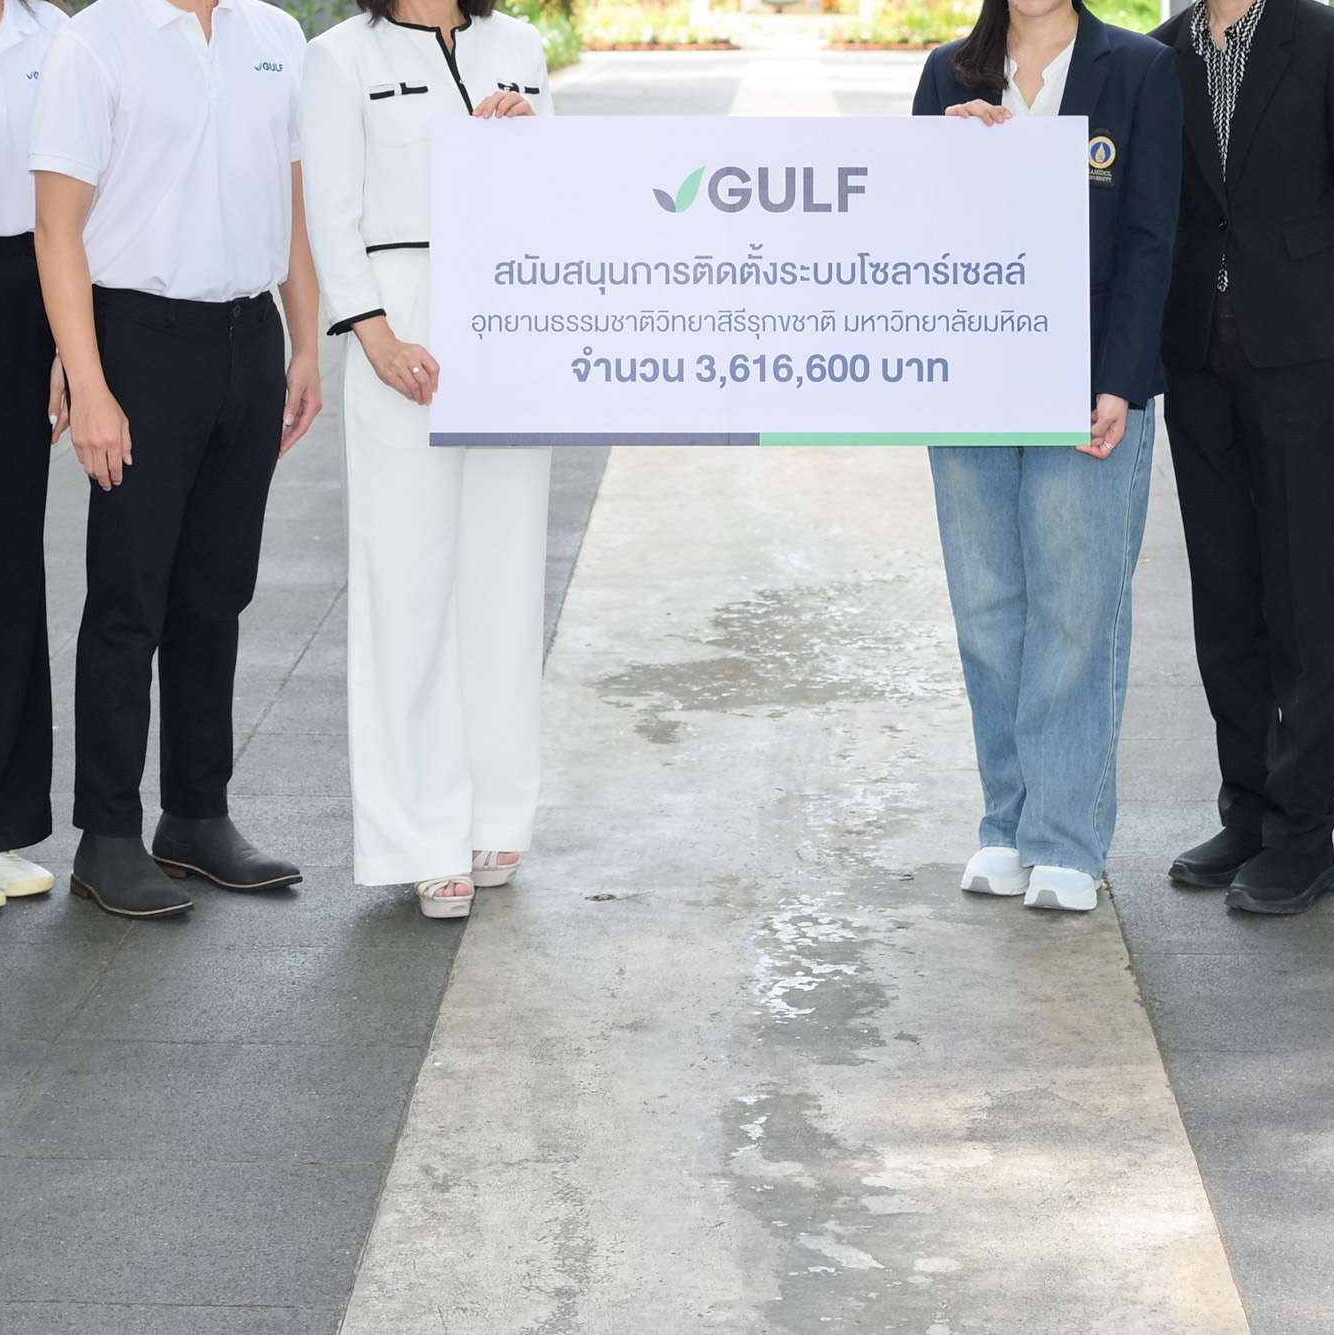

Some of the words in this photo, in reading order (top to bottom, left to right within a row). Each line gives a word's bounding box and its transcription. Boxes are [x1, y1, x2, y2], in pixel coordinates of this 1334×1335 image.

[263, 62, 283, 72] GULF
[708, 167, 868, 213] GULF
[494, 244, 1027, 295] สนับสนุนการติดตั้งระบบโซลาร์เซลล์
[471, 308, 836, 340] อุทยานธรรมชาติวิทยาสิรีรุกขชาติ
[844, 309, 1048, 334] มหาวิทยาลัยมหิดล
[570, 346, 685, 384] จำนวน
[695, 354, 871, 389] 3,616,600
[881, 354, 949, 383] บาท
